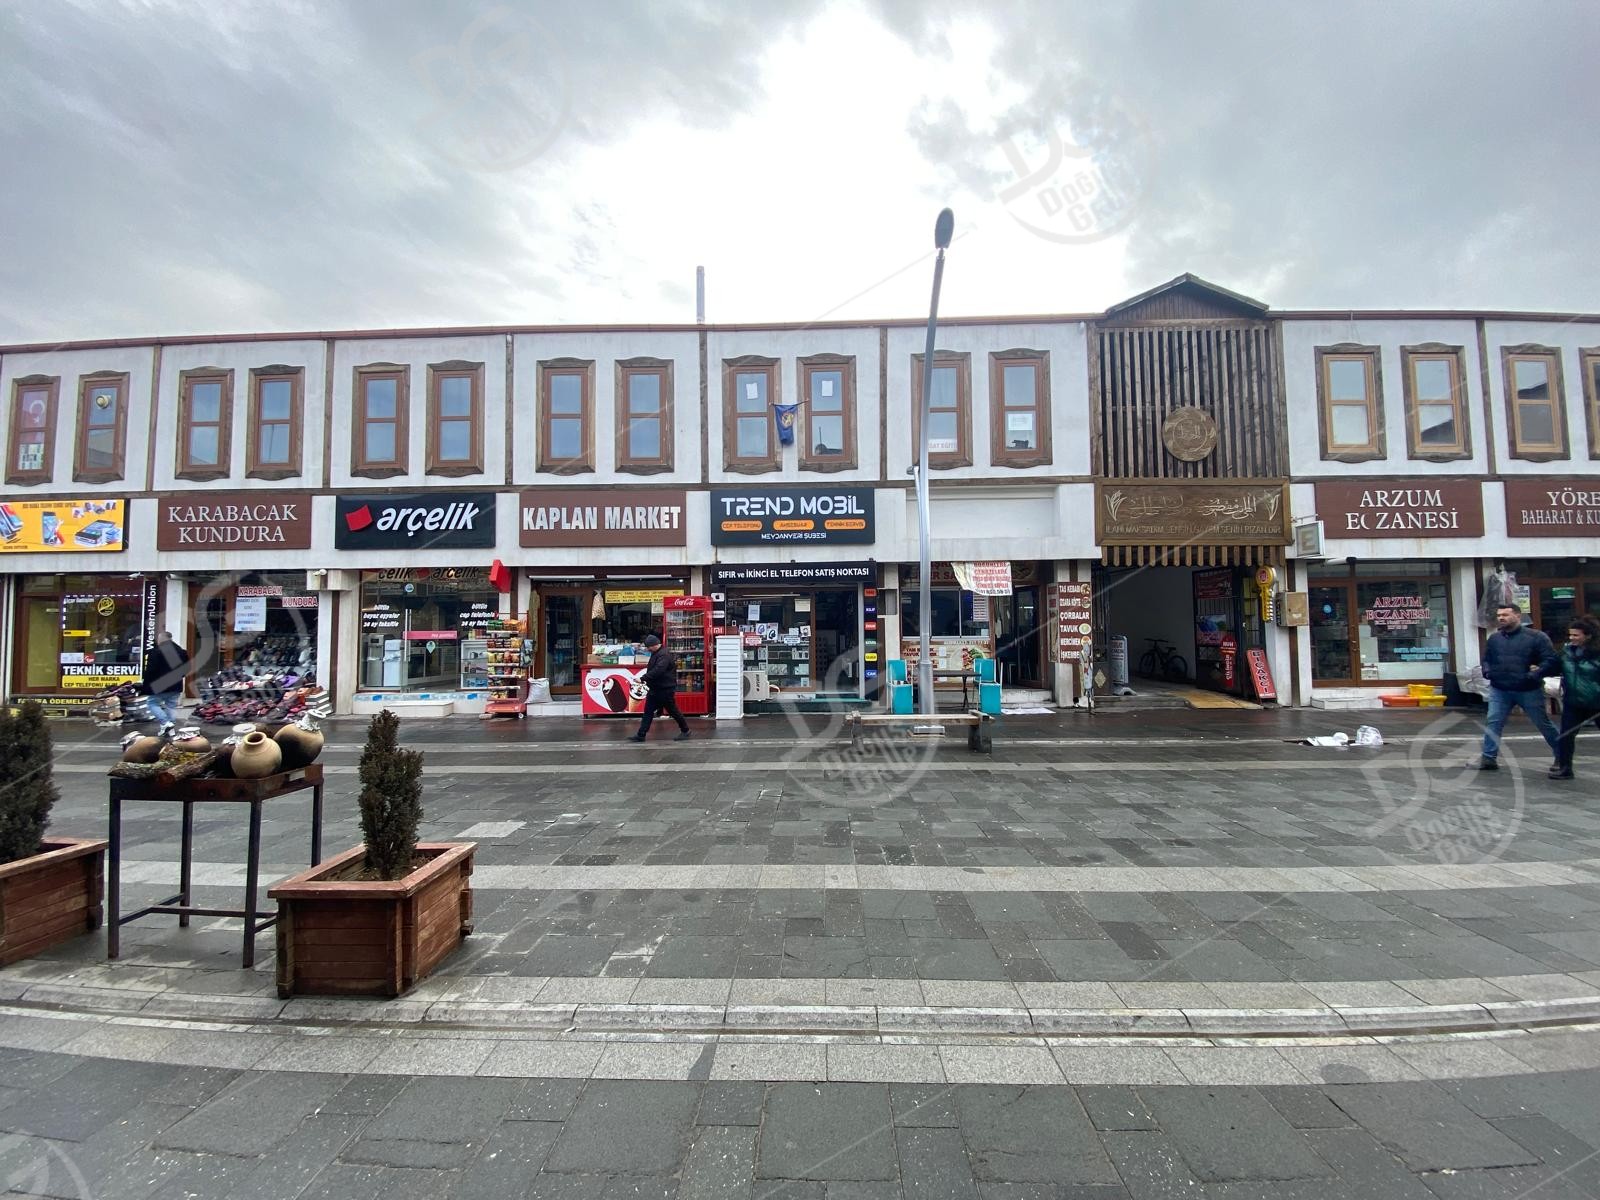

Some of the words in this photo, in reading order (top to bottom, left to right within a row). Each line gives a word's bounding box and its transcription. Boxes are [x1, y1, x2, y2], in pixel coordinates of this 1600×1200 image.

[1360, 490, 1444, 508] ARZUM
[1546, 487, 1600, 506] YÖRE
[720, 496, 794, 516] TREND
[800, 495, 865, 515] MOBİL
[167, 504, 298, 524] KARABACAK
[376, 502, 480, 537] arçelik
[522, 506, 598, 530] KAPLAN
[604, 506, 681, 530] MARKET
[1522, 510, 1573, 524] BAHARAT
[1576, 510, 1584, 524] &
[178, 525, 286, 544] KUNDURA
[718, 570, 736, 578] SIFIR
[746, 568, 770, 578] İKİNCİ
[770, 570, 780, 578] EL
[780, 569, 814, 578] TELEFON
[814, 568, 836, 578] SATIŞ
[836, 568, 869, 576] NOKTASI
[238, 586, 283, 596] KARABACAK
[282, 596, 318, 608] KUNDURA
[1372, 596, 1424, 608] ARZUM
[146, 584, 156, 651] WesternUnion
[1060, 612, 1090, 621] ÇORBALAR
[1366, 607, 1430, 620] ECZANESİ
[1060, 624, 1078, 632] TAVUK
[63, 663, 104, 676] TEKNİK
